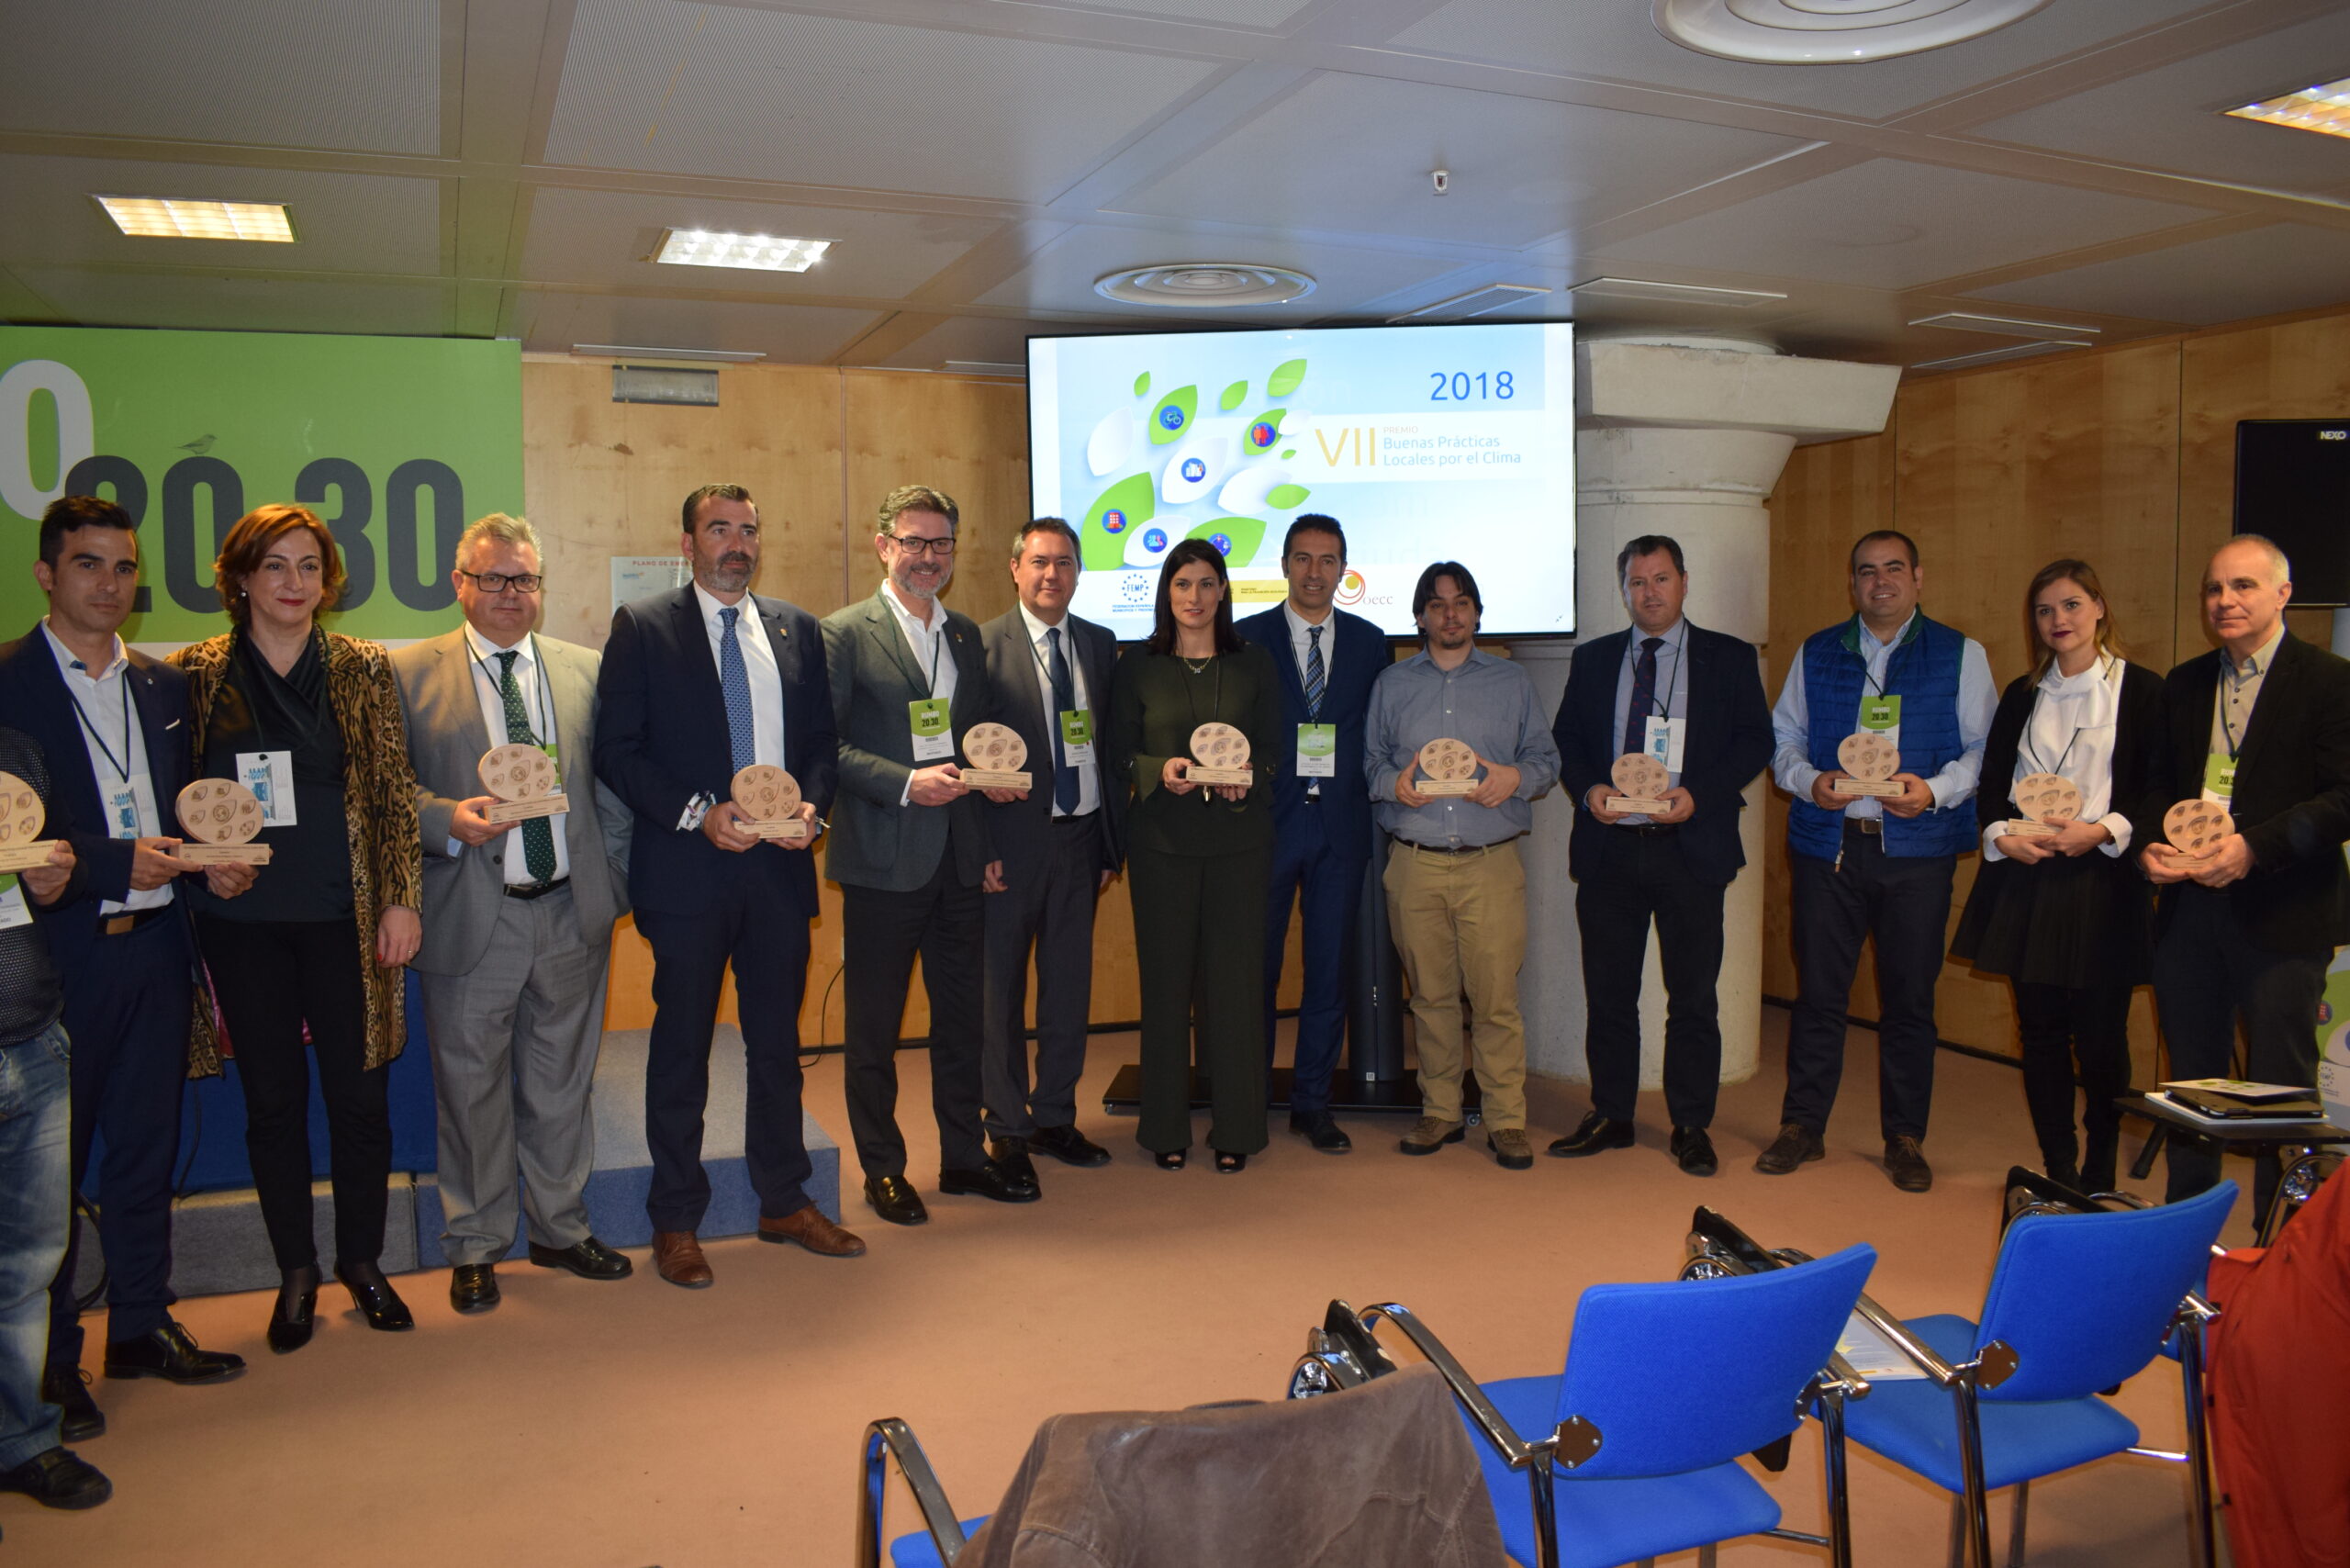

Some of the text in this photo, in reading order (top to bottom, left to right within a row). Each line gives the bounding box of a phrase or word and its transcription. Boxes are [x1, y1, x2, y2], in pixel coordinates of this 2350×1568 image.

[1430, 371, 1515, 400] 2018
[1383, 426, 1418, 434] PREMIO
[2320, 431, 2346, 440] NEXO
[1315, 427, 1376, 467] VII
[1383, 435, 1500, 450] Buenas Prácticas
[1383, 451, 1521, 467] Locales por el Clima
[1127, 584, 1144, 592] FEMP
[1363, 596, 1393, 605] oecc
